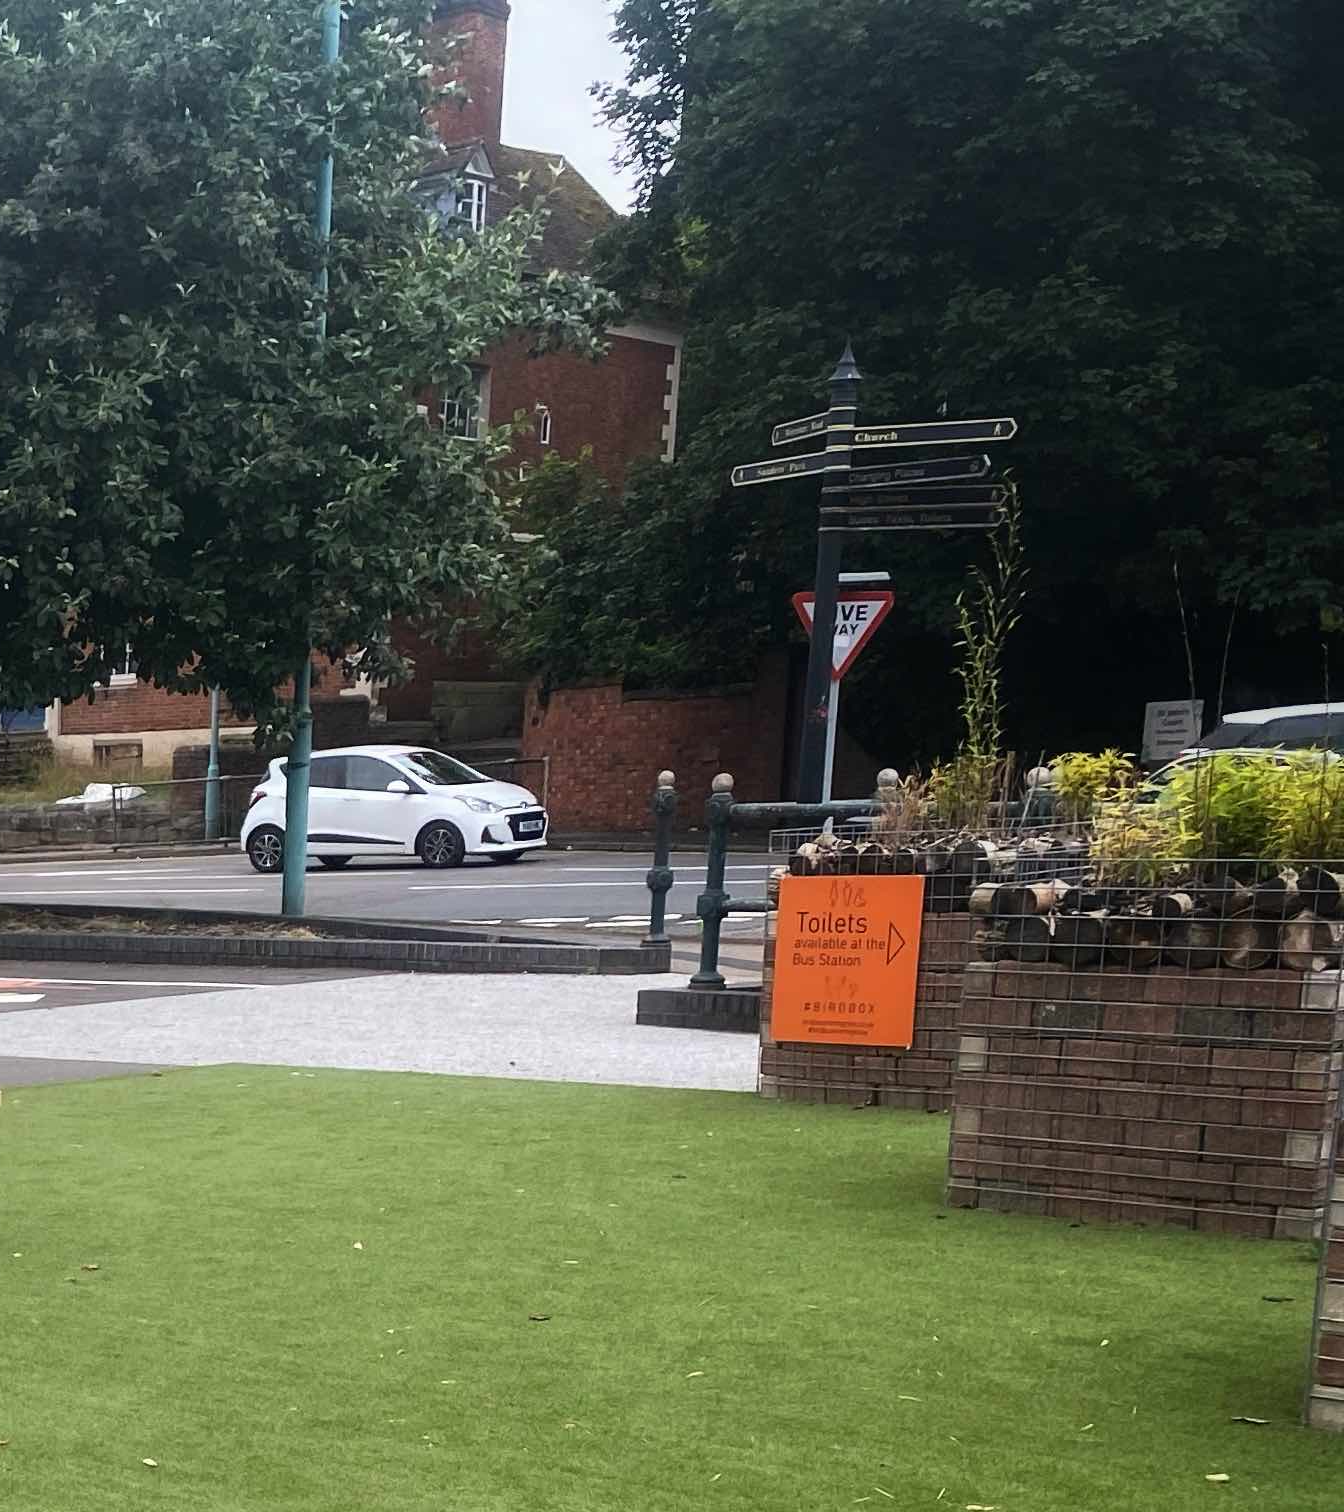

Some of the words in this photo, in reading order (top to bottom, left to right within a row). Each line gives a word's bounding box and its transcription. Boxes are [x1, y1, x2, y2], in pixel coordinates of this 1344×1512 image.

[854, 432, 898, 442] Church
[835, 605, 869, 621] VE
[796, 911, 868, 934] Toilets
[794, 938, 847, 950] available
[850, 938, 862, 950] at
[866, 938, 886, 950] the
[792, 953, 815, 966] Bus
[819, 953, 861, 966] Station
